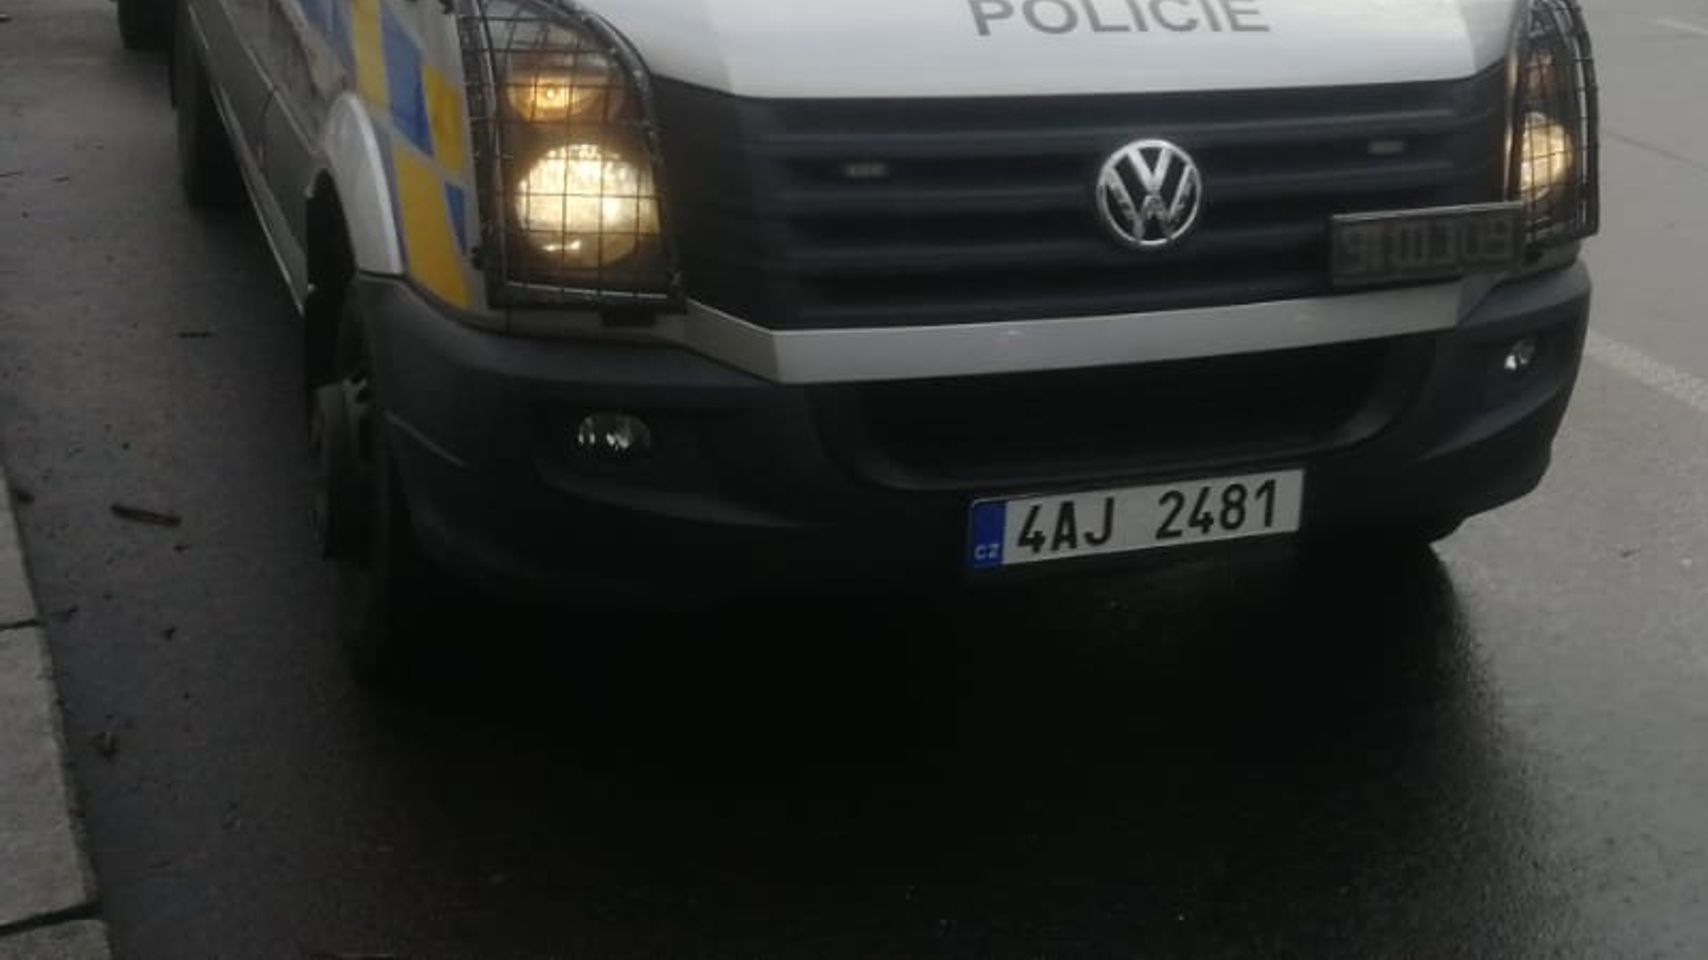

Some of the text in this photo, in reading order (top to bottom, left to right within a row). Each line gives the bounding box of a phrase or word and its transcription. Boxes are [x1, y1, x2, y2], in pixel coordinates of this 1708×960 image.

[1017, 479, 1276, 554] 4AJ 2481
[974, 543, 999, 560] CZ
